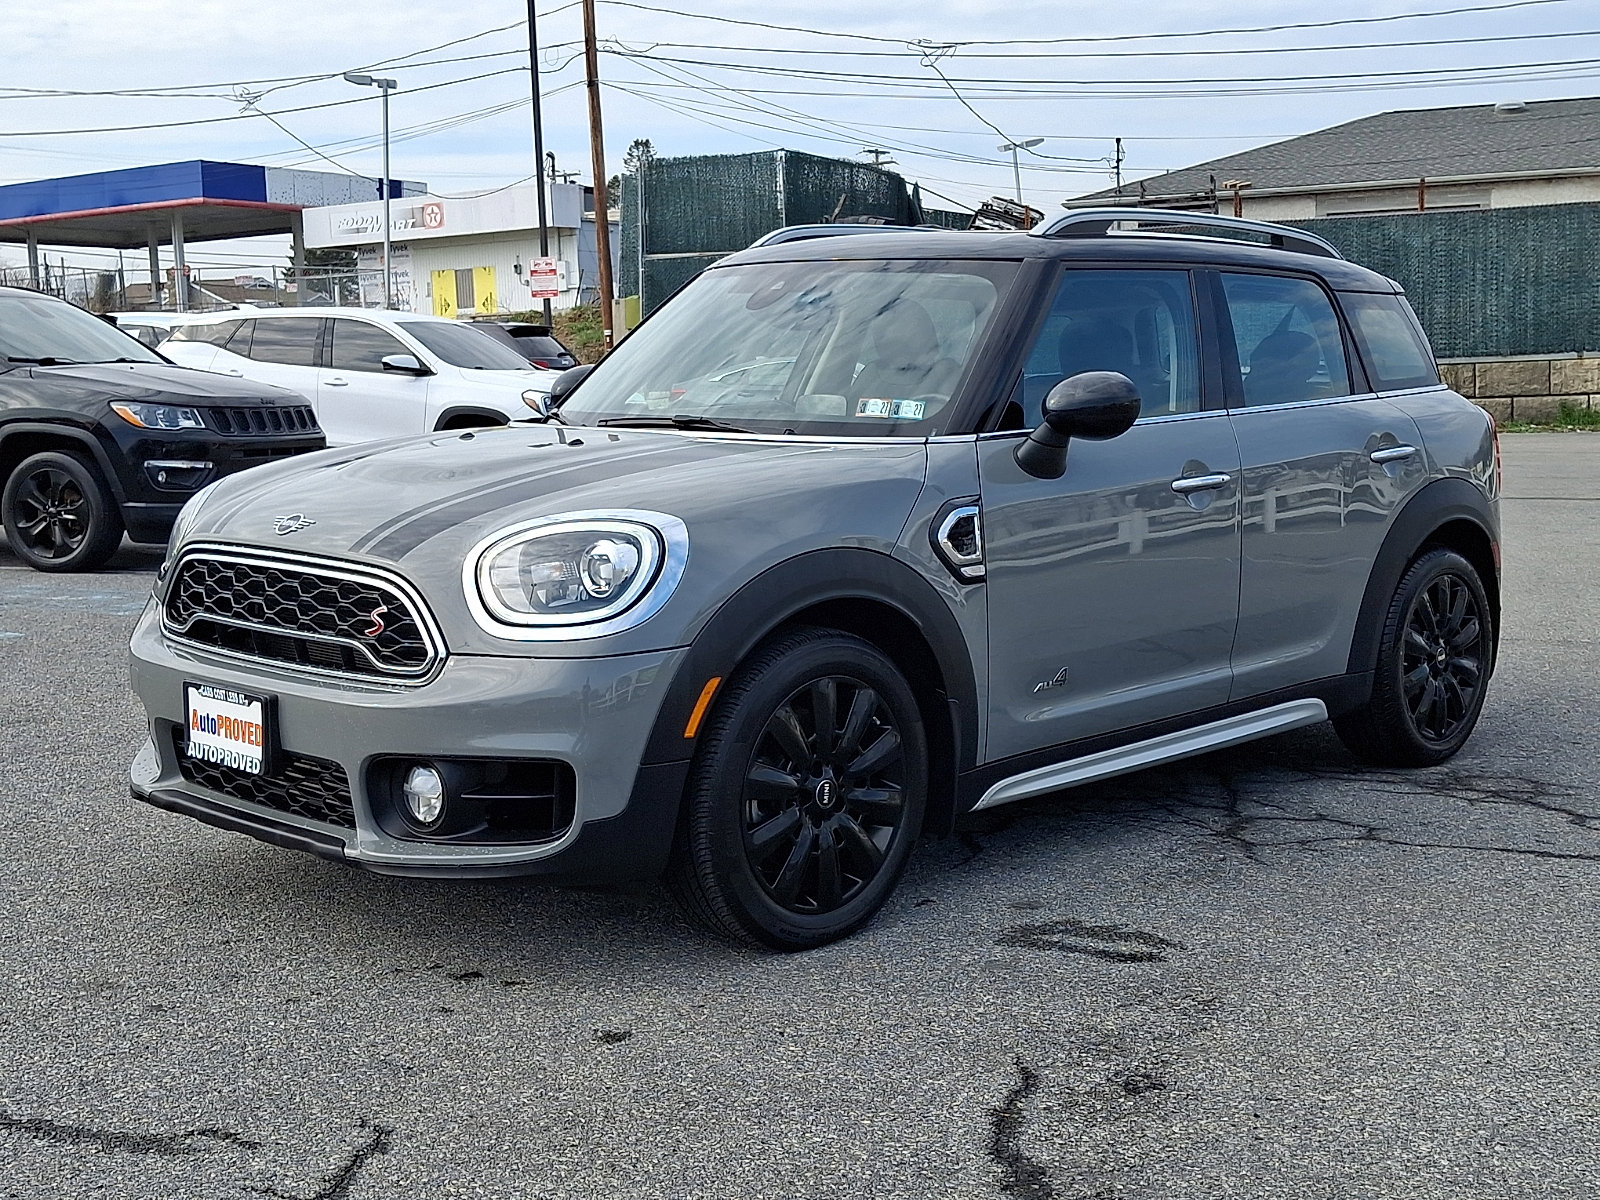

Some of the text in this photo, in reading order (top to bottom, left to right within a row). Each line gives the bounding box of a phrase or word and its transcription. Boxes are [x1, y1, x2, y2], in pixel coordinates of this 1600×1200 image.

[880, 402, 889, 414] 27
[913, 404, 923, 416] 27
[365, 605, 387, 636] S
[213, 688, 226, 701] COST
[226, 691, 238, 704] LESS
[192, 709, 263, 746] AutoPROVED
[187, 742, 260, 774] AUTOPROVED
[822, 783, 830, 804] MINI
